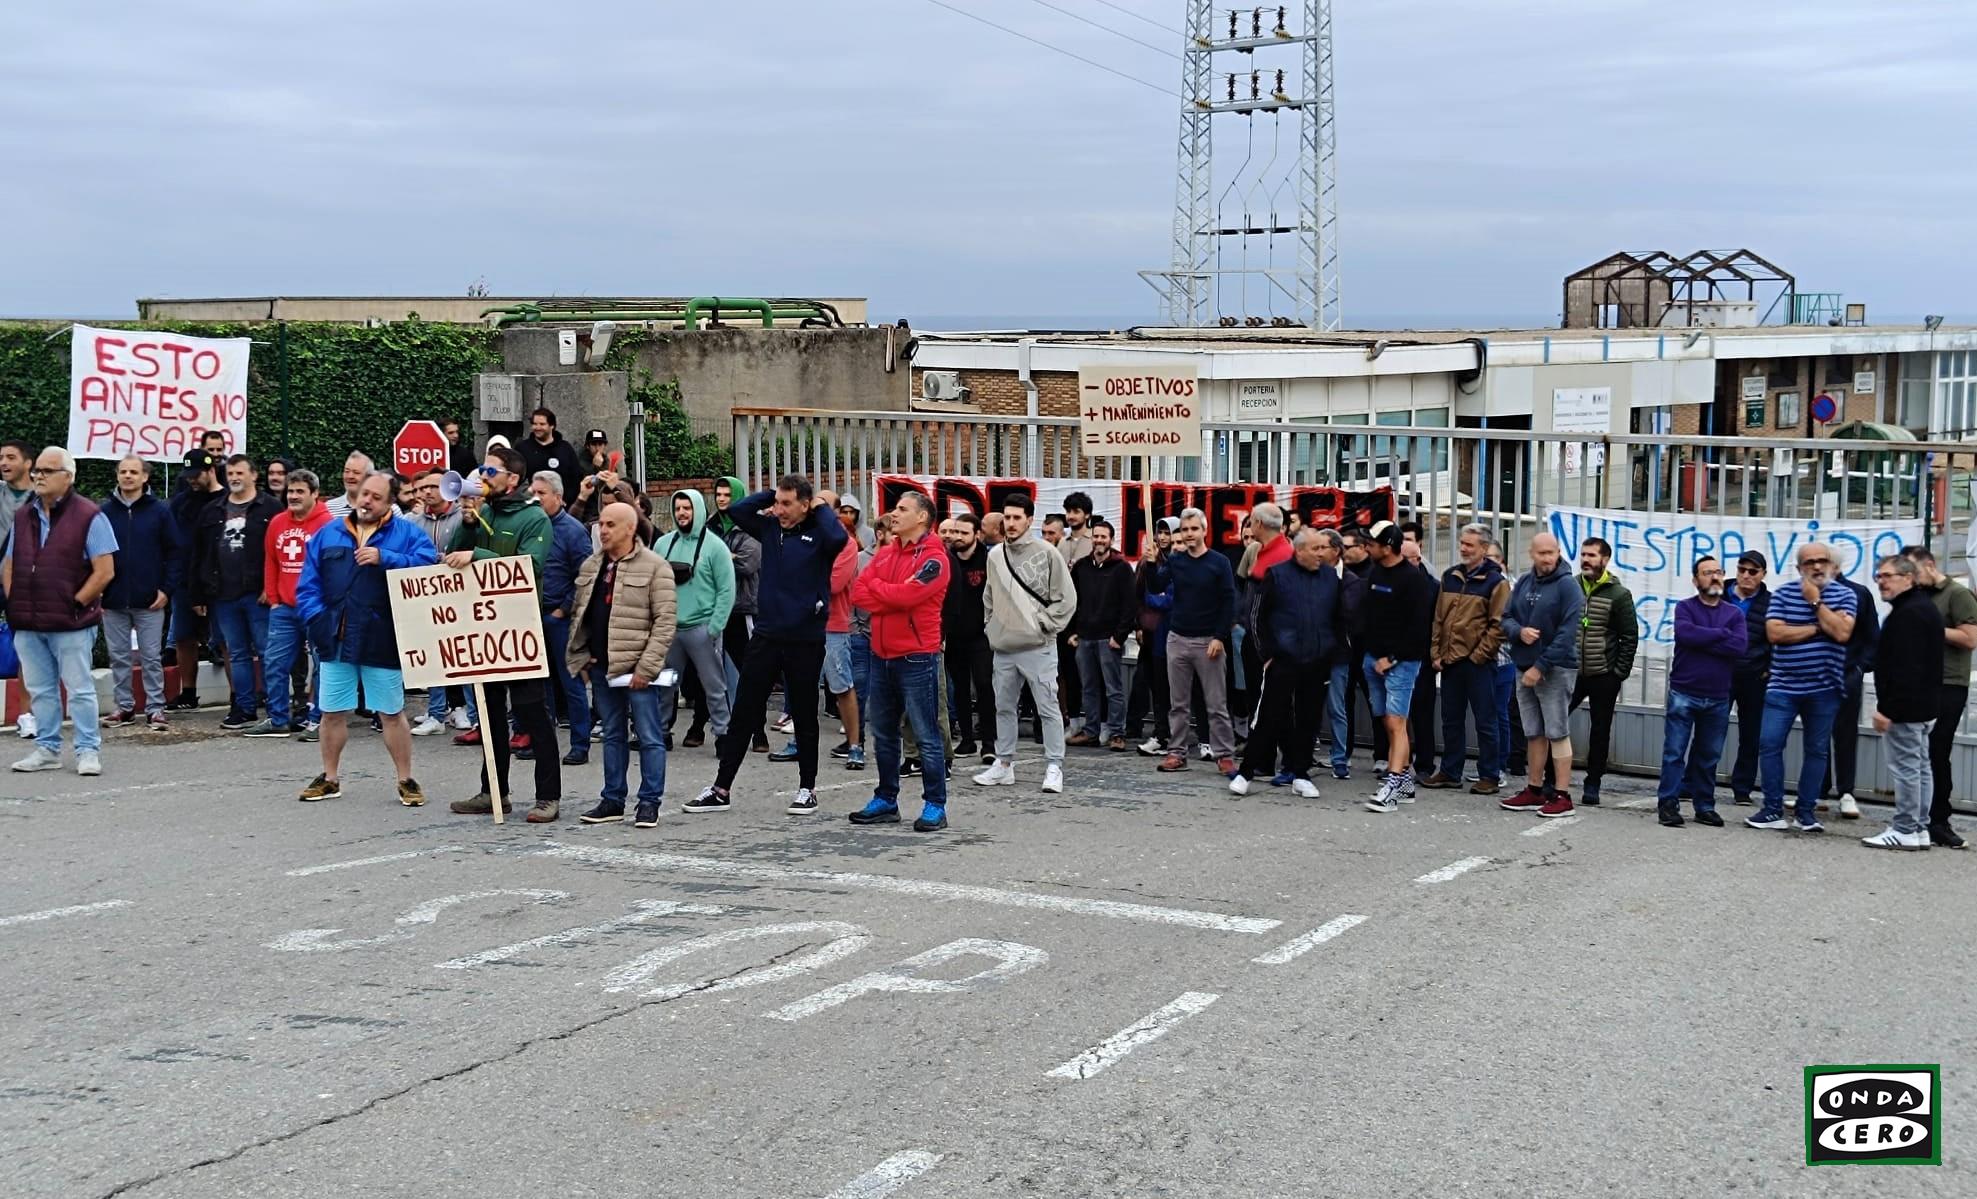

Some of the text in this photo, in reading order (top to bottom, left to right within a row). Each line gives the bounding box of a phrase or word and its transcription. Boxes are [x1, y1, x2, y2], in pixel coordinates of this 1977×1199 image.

[95, 336, 221, 381] ESTO
[80, 376, 246, 425] ANTES NO
[1105, 376, 1194, 397] OBJETIVOS
[399, 447, 443, 464] STOP
[1549, 510, 1747, 577] NUESTRA
[400, 560, 529, 600] NUESTRA VIDA
[431, 600, 497, 625] NO ES
[405, 629, 539, 668] TU NEGOCIO
[262, 887, 1050, 1022] STOP
